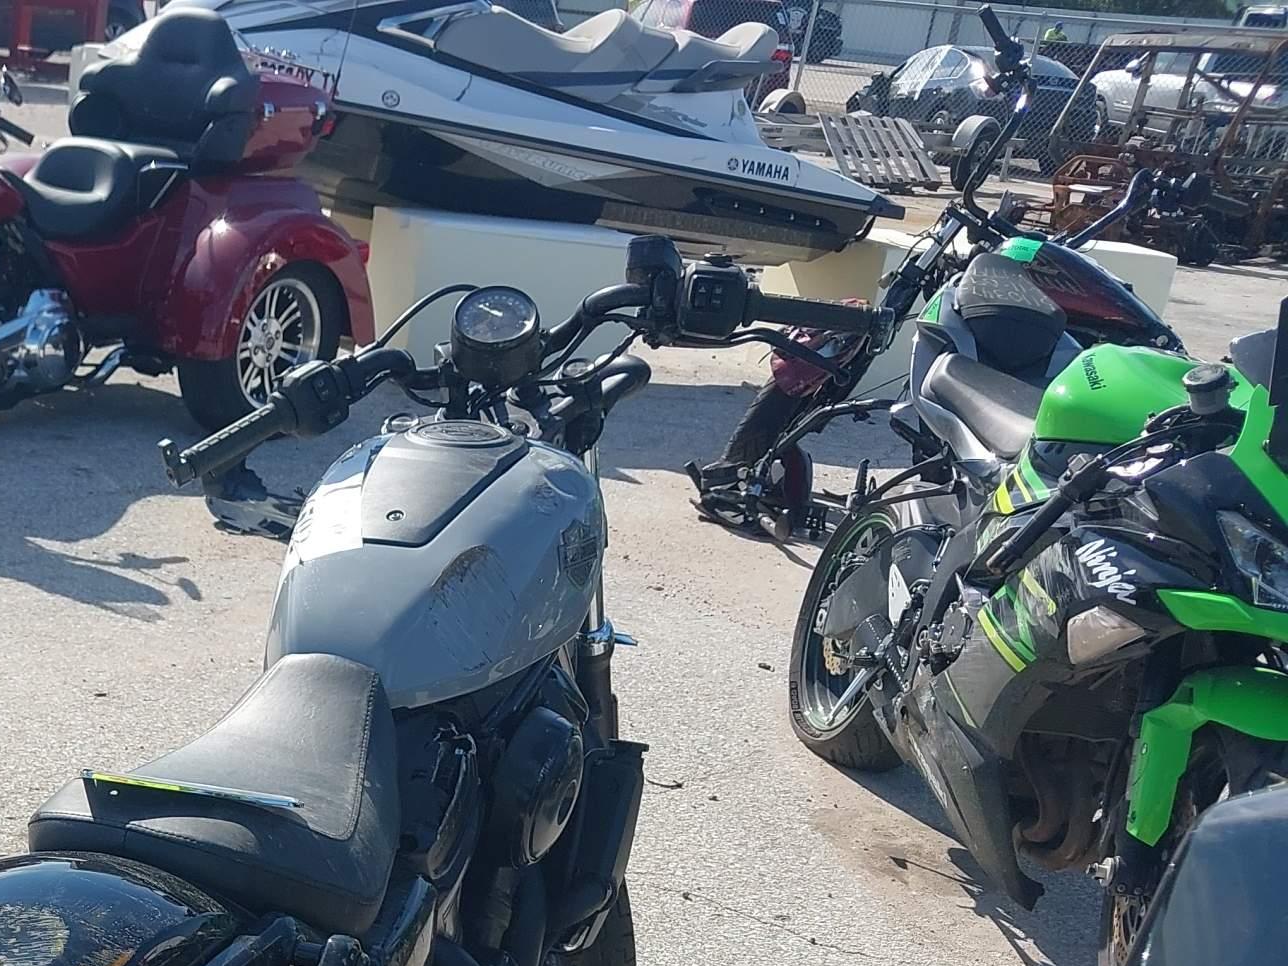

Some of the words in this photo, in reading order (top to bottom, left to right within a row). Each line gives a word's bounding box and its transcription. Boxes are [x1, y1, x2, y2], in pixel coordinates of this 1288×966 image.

[742, 159, 789, 180] YAMAHA
[1082, 352, 1107, 391] Kawasaki
[1075, 539, 1136, 605] Ninja
